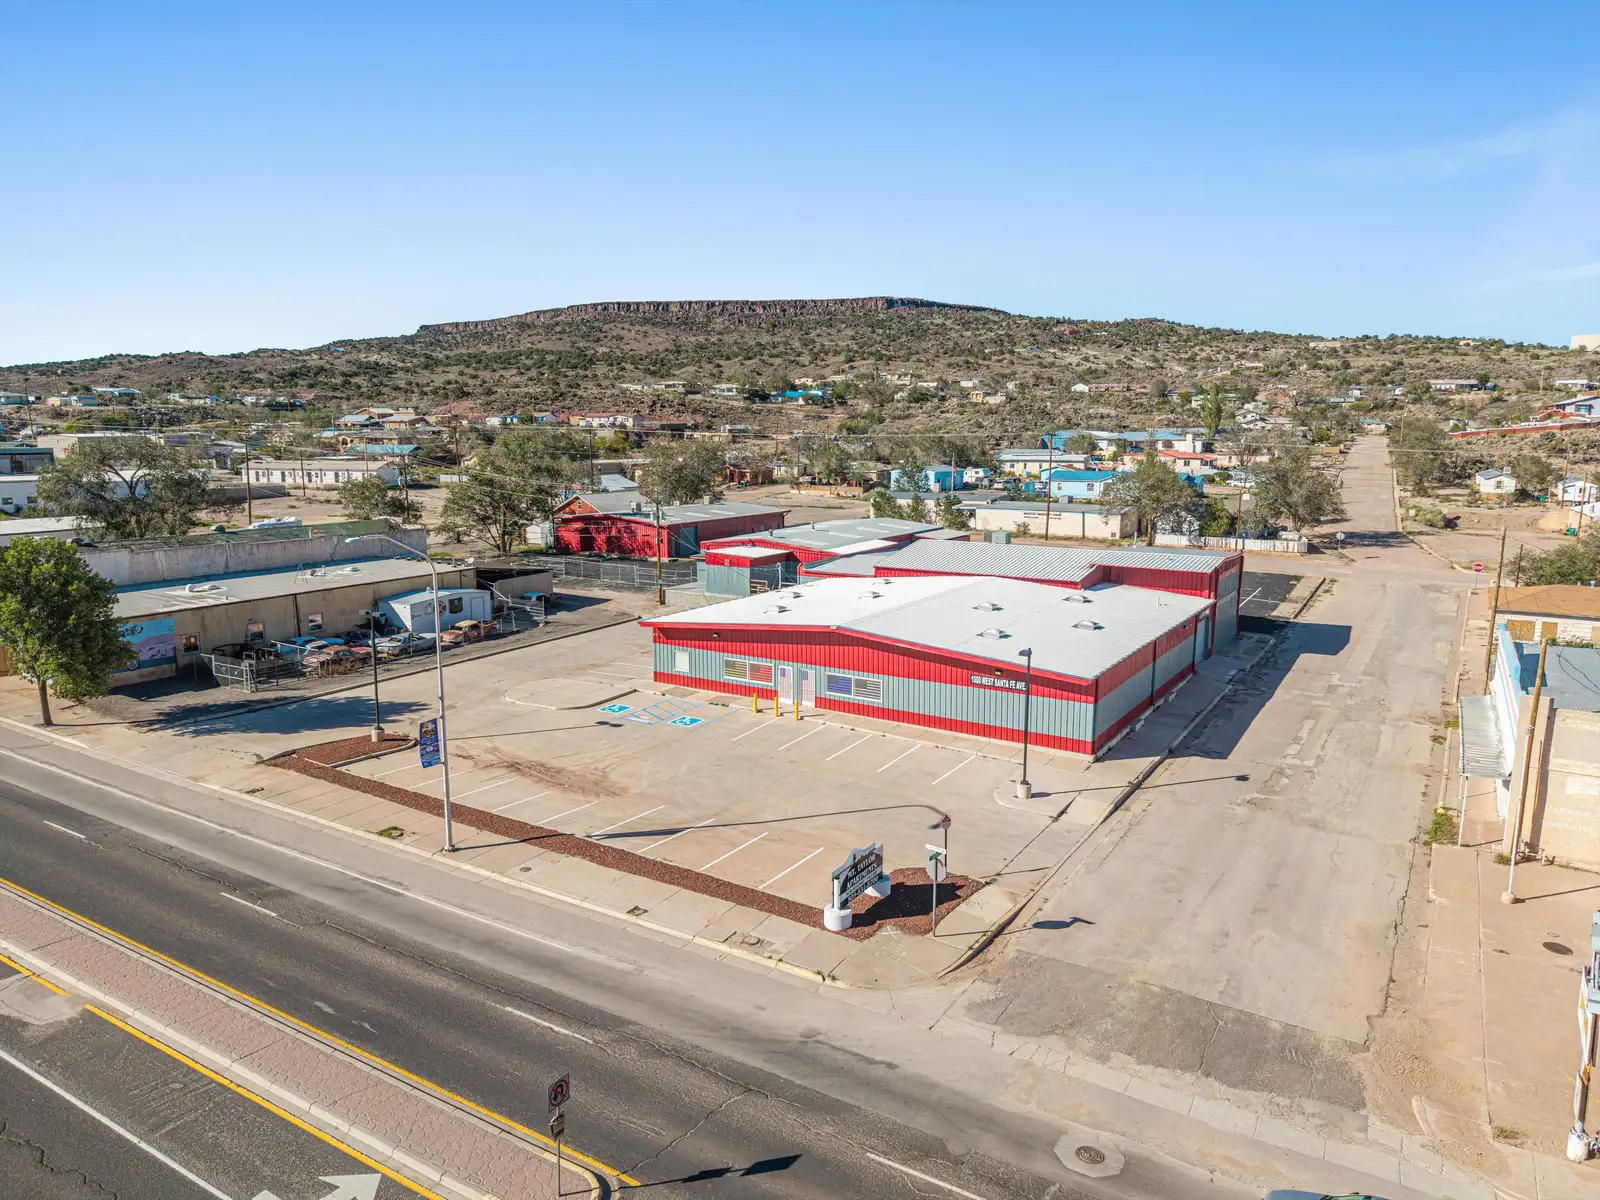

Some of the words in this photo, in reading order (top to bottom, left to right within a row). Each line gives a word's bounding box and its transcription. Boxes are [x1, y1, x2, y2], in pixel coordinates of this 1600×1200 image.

[981, 676, 994, 686] WEST
[994, 678, 1009, 688] SANTA
[1010, 680, 1015, 688] FE
[857, 854, 876, 870] TAYLOR
